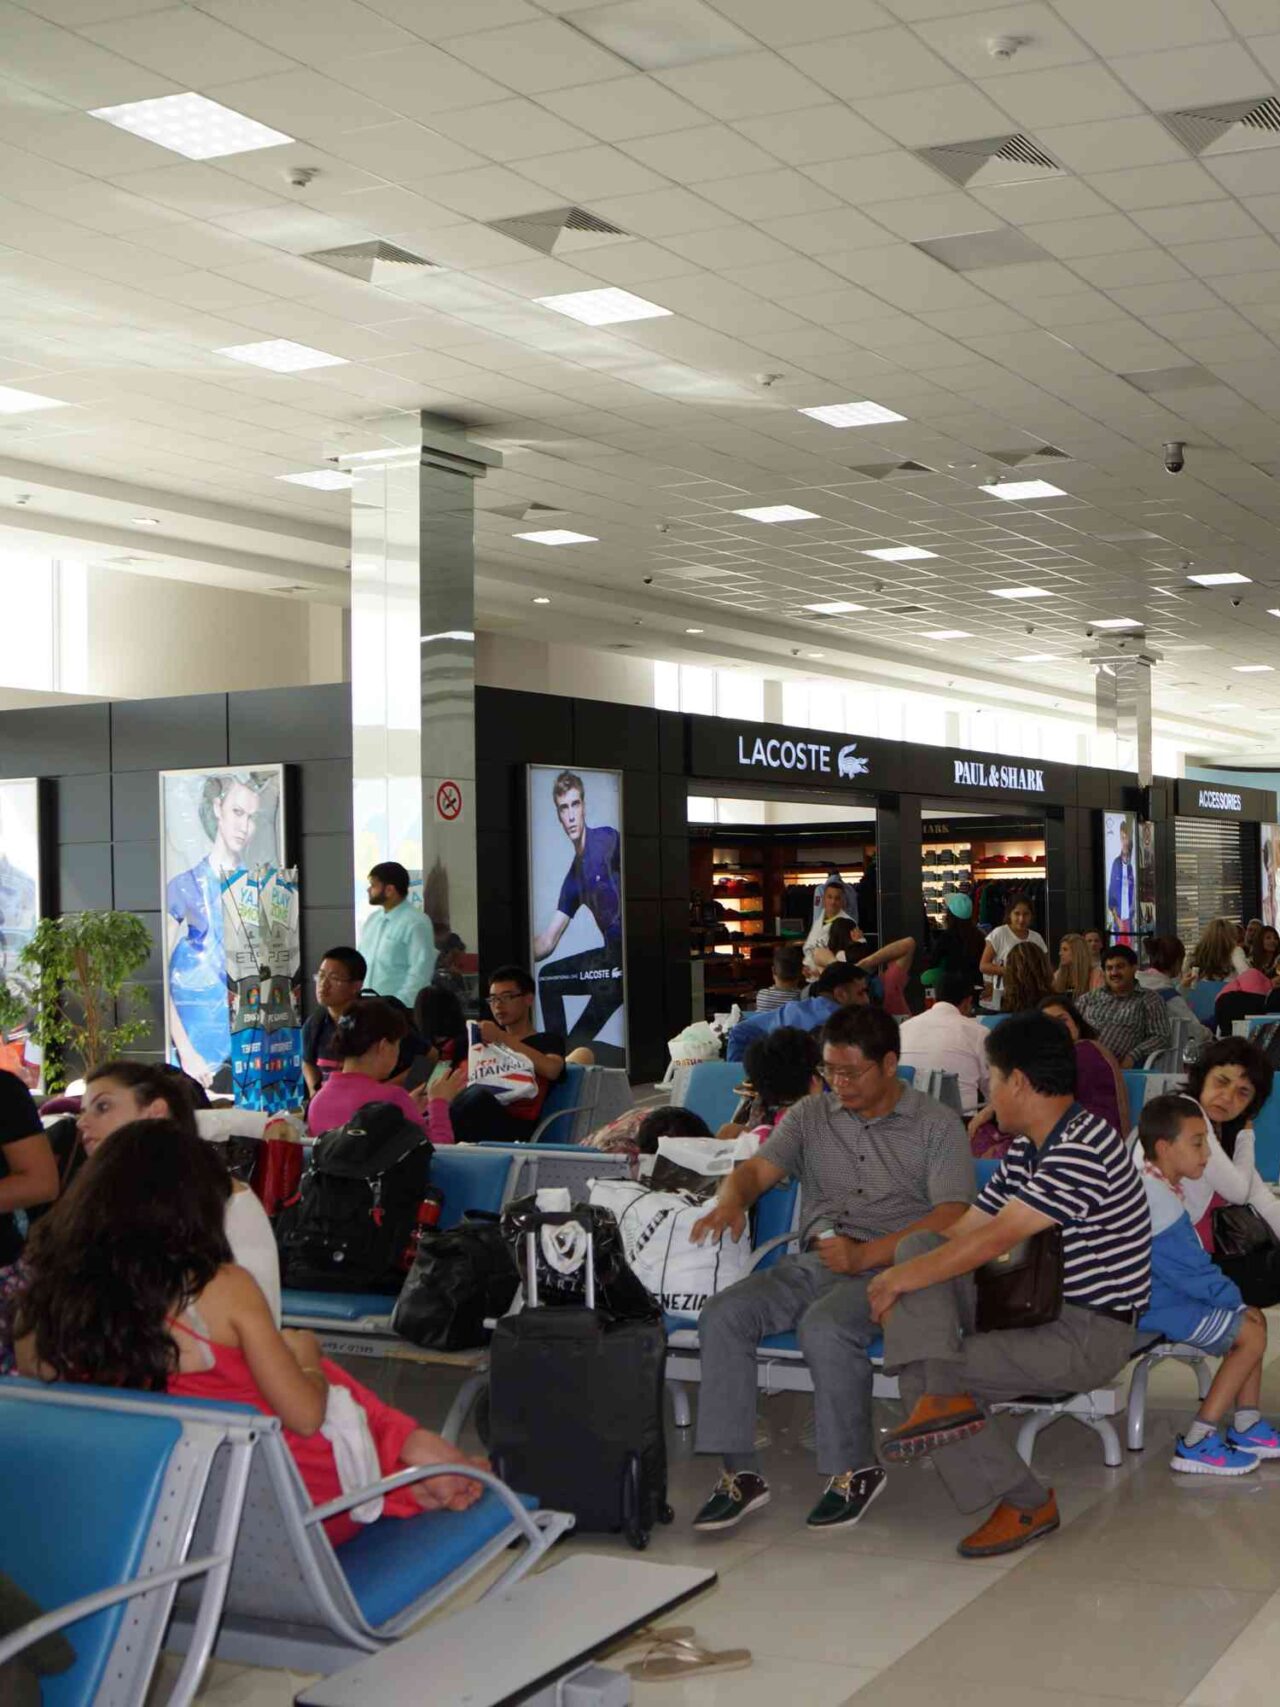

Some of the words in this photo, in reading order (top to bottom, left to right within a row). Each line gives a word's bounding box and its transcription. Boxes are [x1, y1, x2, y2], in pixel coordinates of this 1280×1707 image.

[738, 735, 831, 772] LACOSTE
[953, 760, 988, 787] PAUL
[1000, 765, 1045, 792] SHARK
[1198, 790, 1242, 811] ACCESSORIES
[580, 969, 611, 981] LACOSTE
